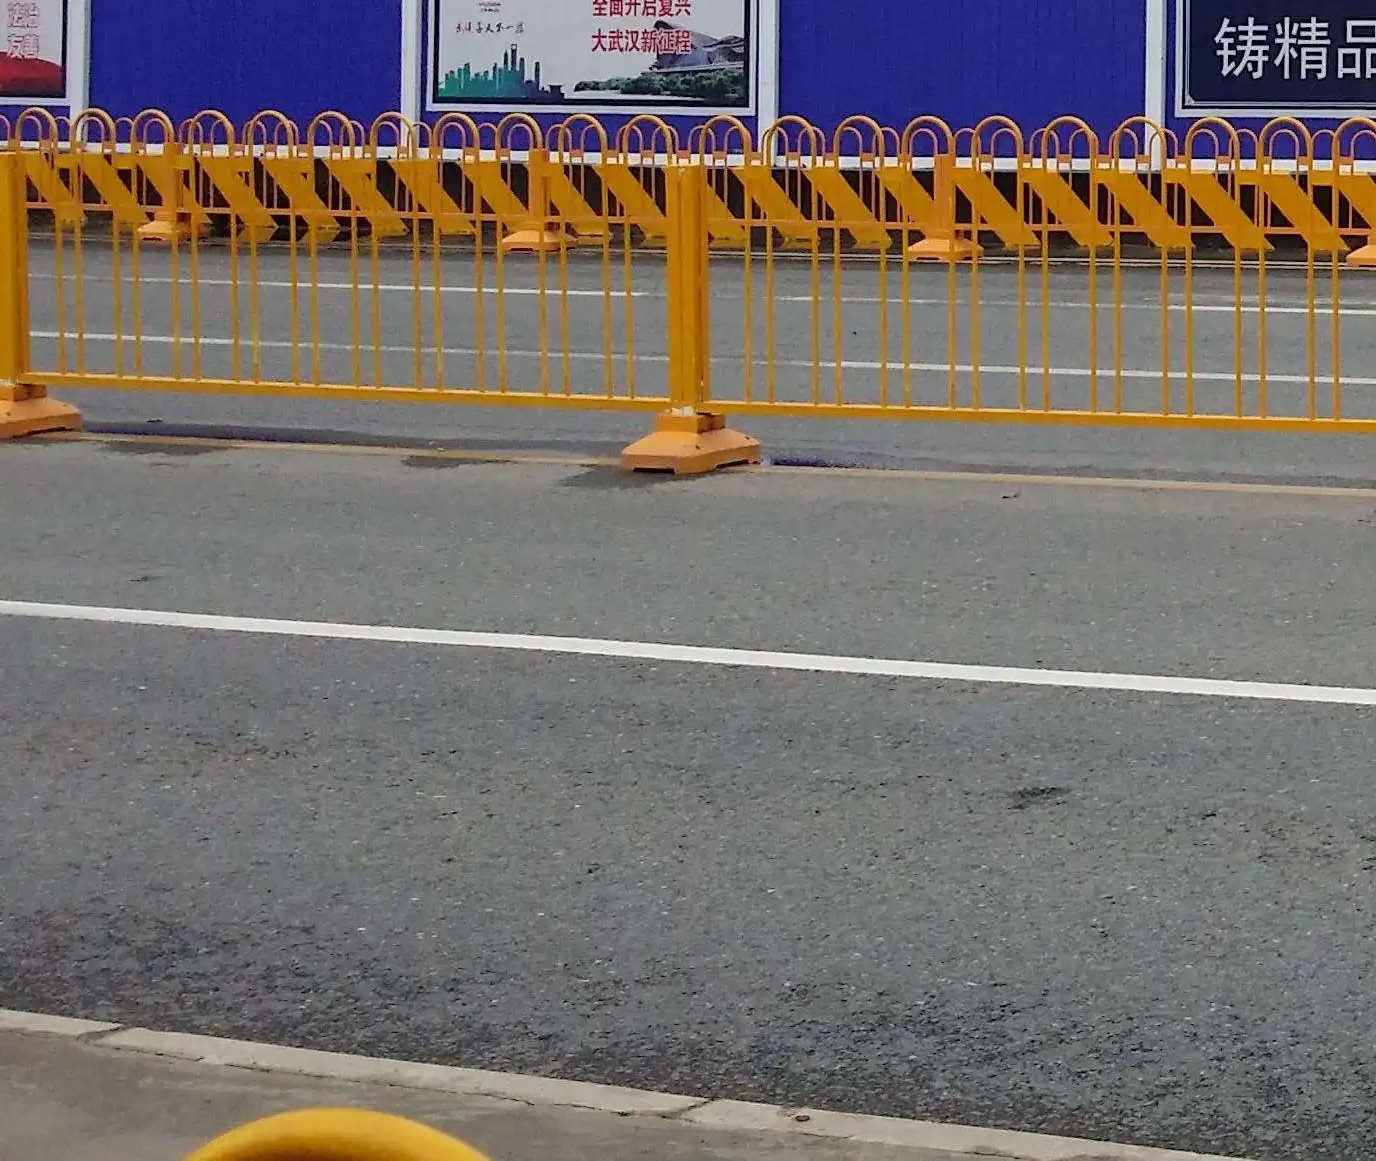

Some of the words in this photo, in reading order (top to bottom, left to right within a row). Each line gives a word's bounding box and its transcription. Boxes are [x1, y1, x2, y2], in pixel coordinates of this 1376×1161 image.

[591, 28, 692, 54] 大武汉新征程
